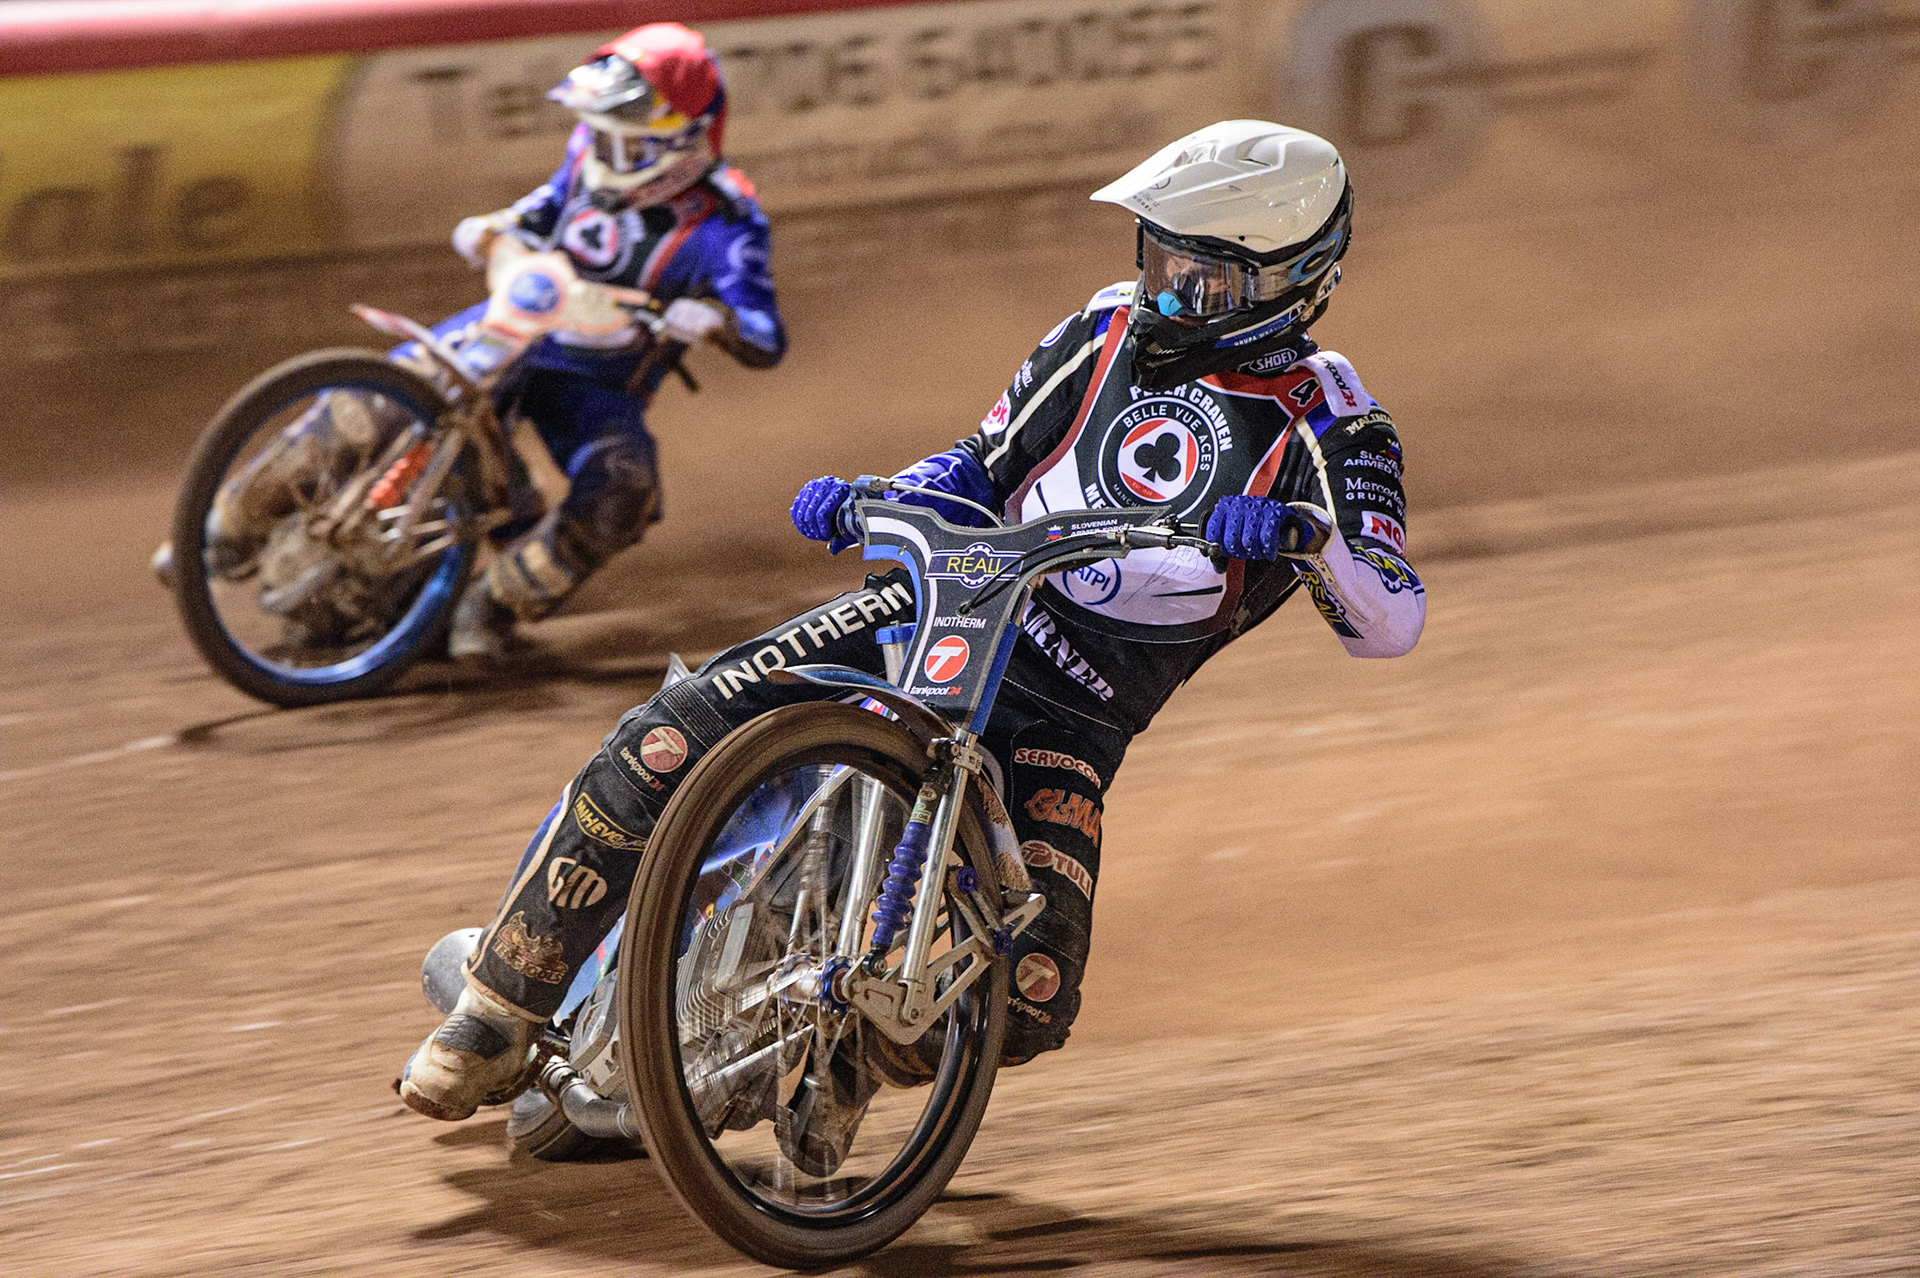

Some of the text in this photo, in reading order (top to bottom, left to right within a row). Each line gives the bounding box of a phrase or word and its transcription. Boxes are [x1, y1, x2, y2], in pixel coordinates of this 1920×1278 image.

[1256, 350, 1293, 370] SHOEI
[1288, 377, 1320, 407] 4
[1188, 387, 1234, 452] CRAVEN
[1122, 404, 1212, 472] BELLE VUE ACES
[1343, 458, 1393, 475] ARMED
[1360, 450, 1400, 471] SLOVE
[1345, 492, 1393, 508] GRUPA
[1071, 519, 1118, 531] SLOVENIAN
[1071, 564, 1111, 592] ATPI
[933, 616, 987, 630] INOTHERM
[711, 582, 914, 700] INOTHERM
